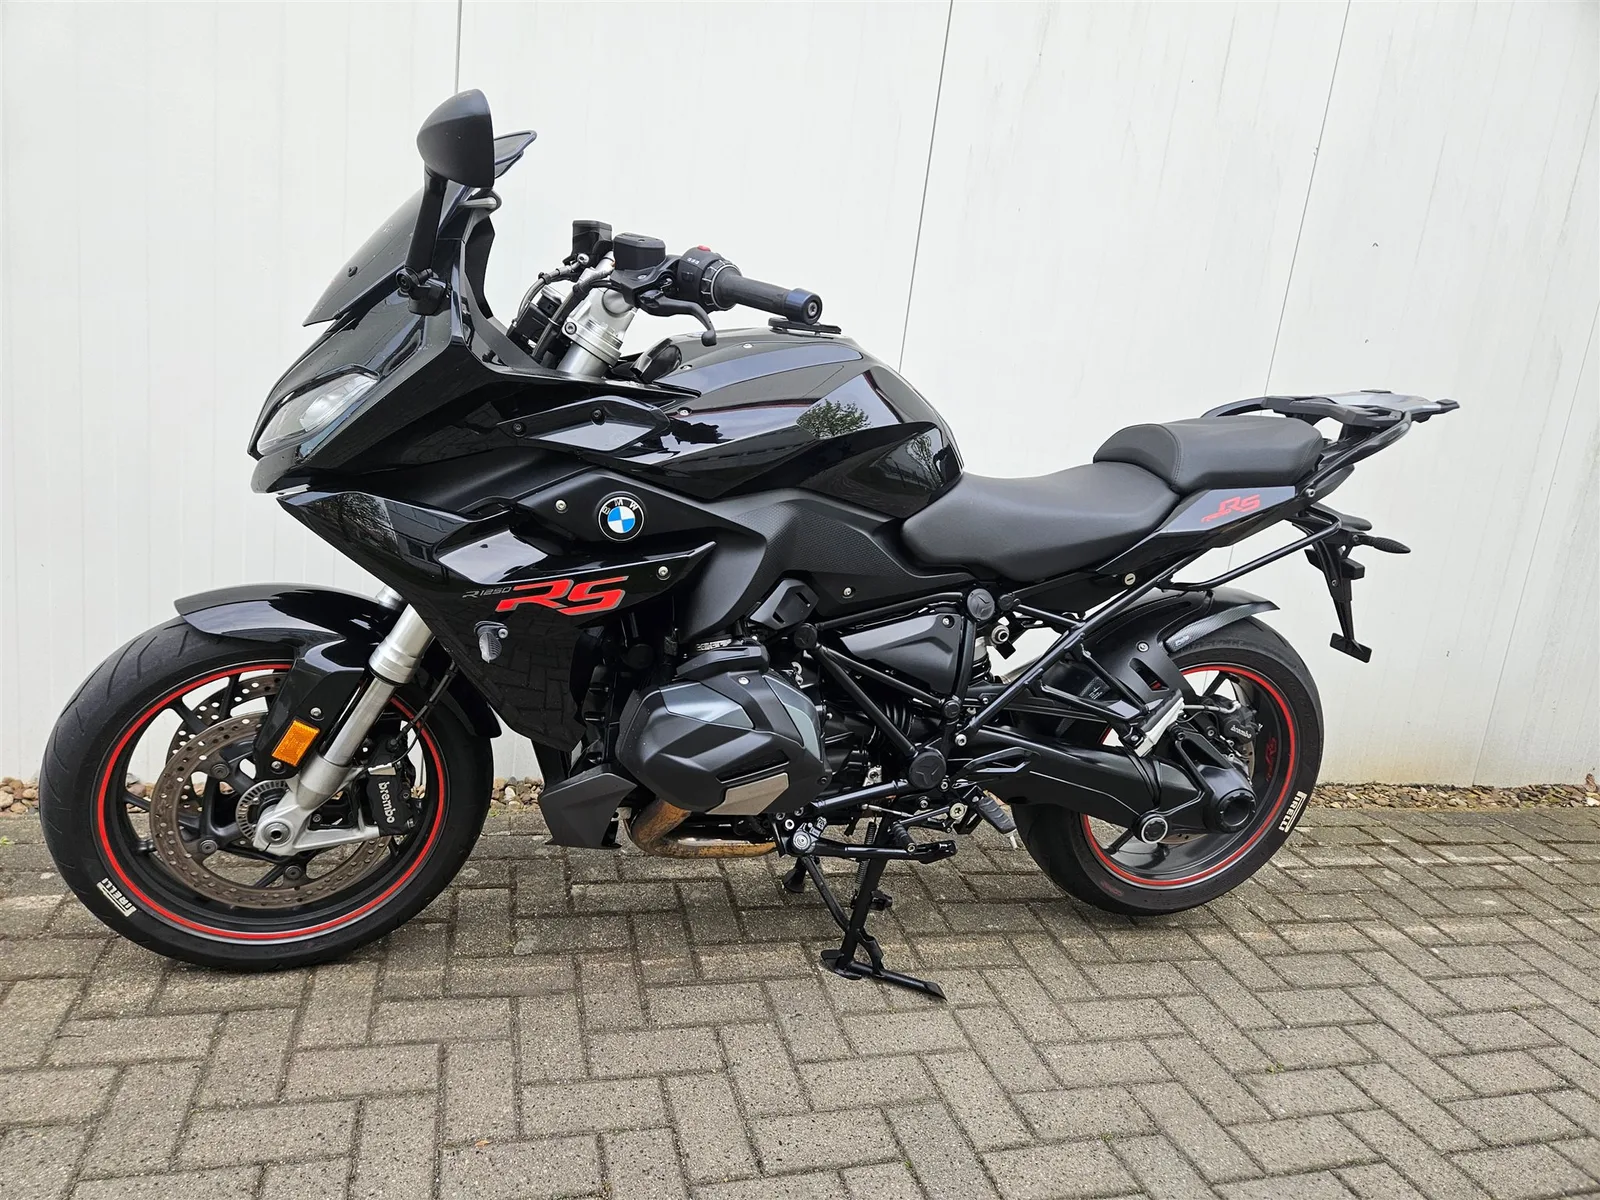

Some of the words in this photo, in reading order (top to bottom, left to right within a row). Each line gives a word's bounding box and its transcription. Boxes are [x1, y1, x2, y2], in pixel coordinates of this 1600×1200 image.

[601, 499, 639, 515] BMW
[1201, 494, 1260, 523] RS
[495, 576, 629, 616] RS
[378, 781, 396, 823] brembo
[1278, 791, 1307, 833] PIRELLI
[96, 877, 137, 917] PIRELLI
